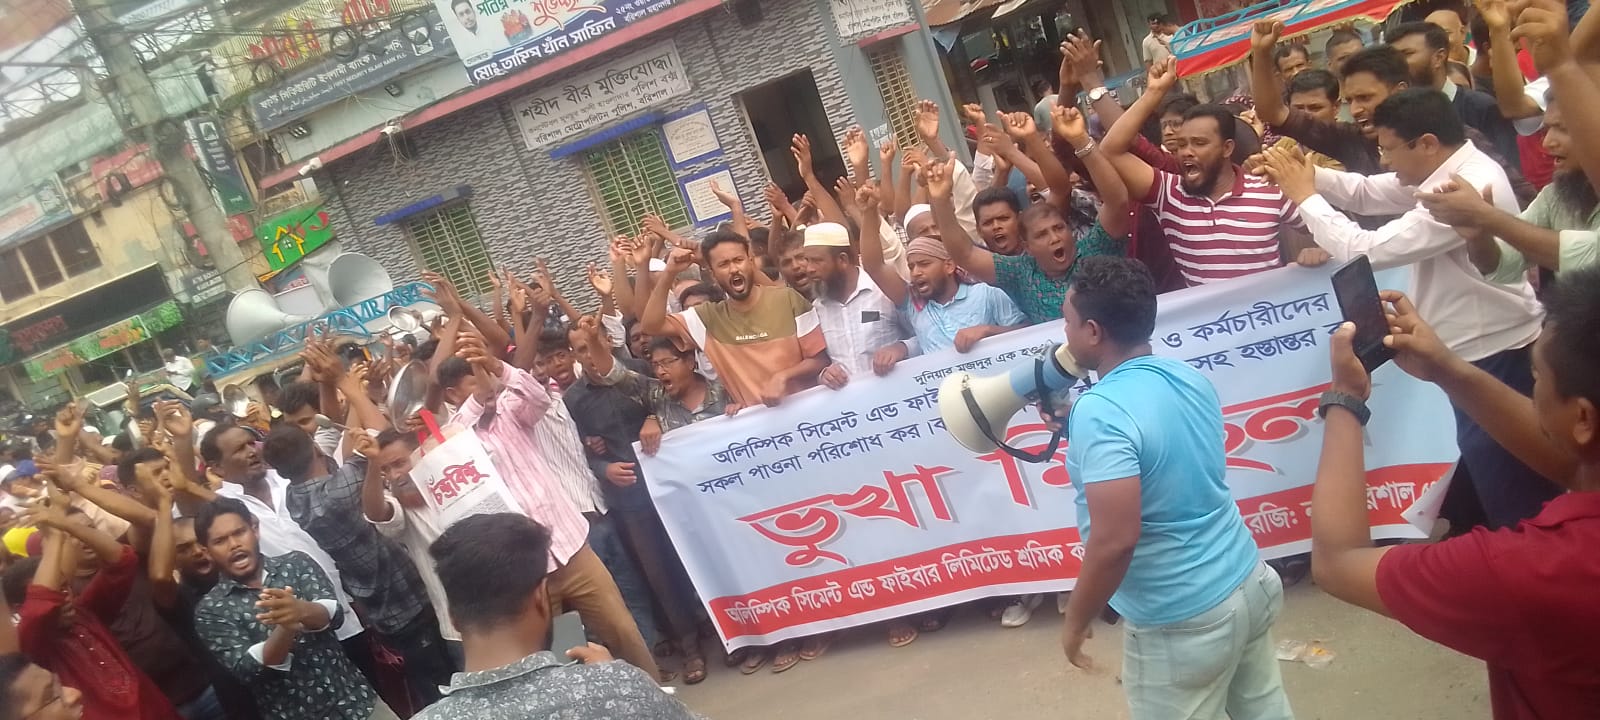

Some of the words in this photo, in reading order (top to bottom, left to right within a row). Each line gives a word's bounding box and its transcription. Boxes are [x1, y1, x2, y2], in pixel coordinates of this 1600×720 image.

[569, 16, 617, 45] সাফিন
[519, 97, 561, 121] শহীদ
[562, 84, 593, 104] বীর
[595, 53, 674, 96] মুক্তিযোদ্ধা
[630, 79, 659, 97] পুলিশ
[711, 427, 794, 466] অলিম্পিক
[797, 409, 860, 444] সিমেন্ট
[865, 400, 899, 424] এন্ড
[1161, 332, 1183, 348] ও
[1187, 293, 1330, 342] কর্মচারীদের
[955, 354, 993, 374] মজদুর
[995, 350, 1017, 363] এক
[698, 468, 745, 496] সকল
[748, 452, 803, 479] পাওনা
[807, 430, 883, 468] পরিশোধ
[890, 425, 922, 446] কর
[1236, 328, 1317, 361] হস্তান্তর
[735, 463, 965, 567] ভুখা
[725, 594, 792, 626] অলিম্পিক
[794, 579, 844, 611] সিমেন্ট
[847, 575, 876, 598] এন্ড
[878, 560, 942, 595] ফাইবার
[944, 543, 1014, 579] লিমিটেড
[1016, 537, 1062, 568] শ্রমিক
